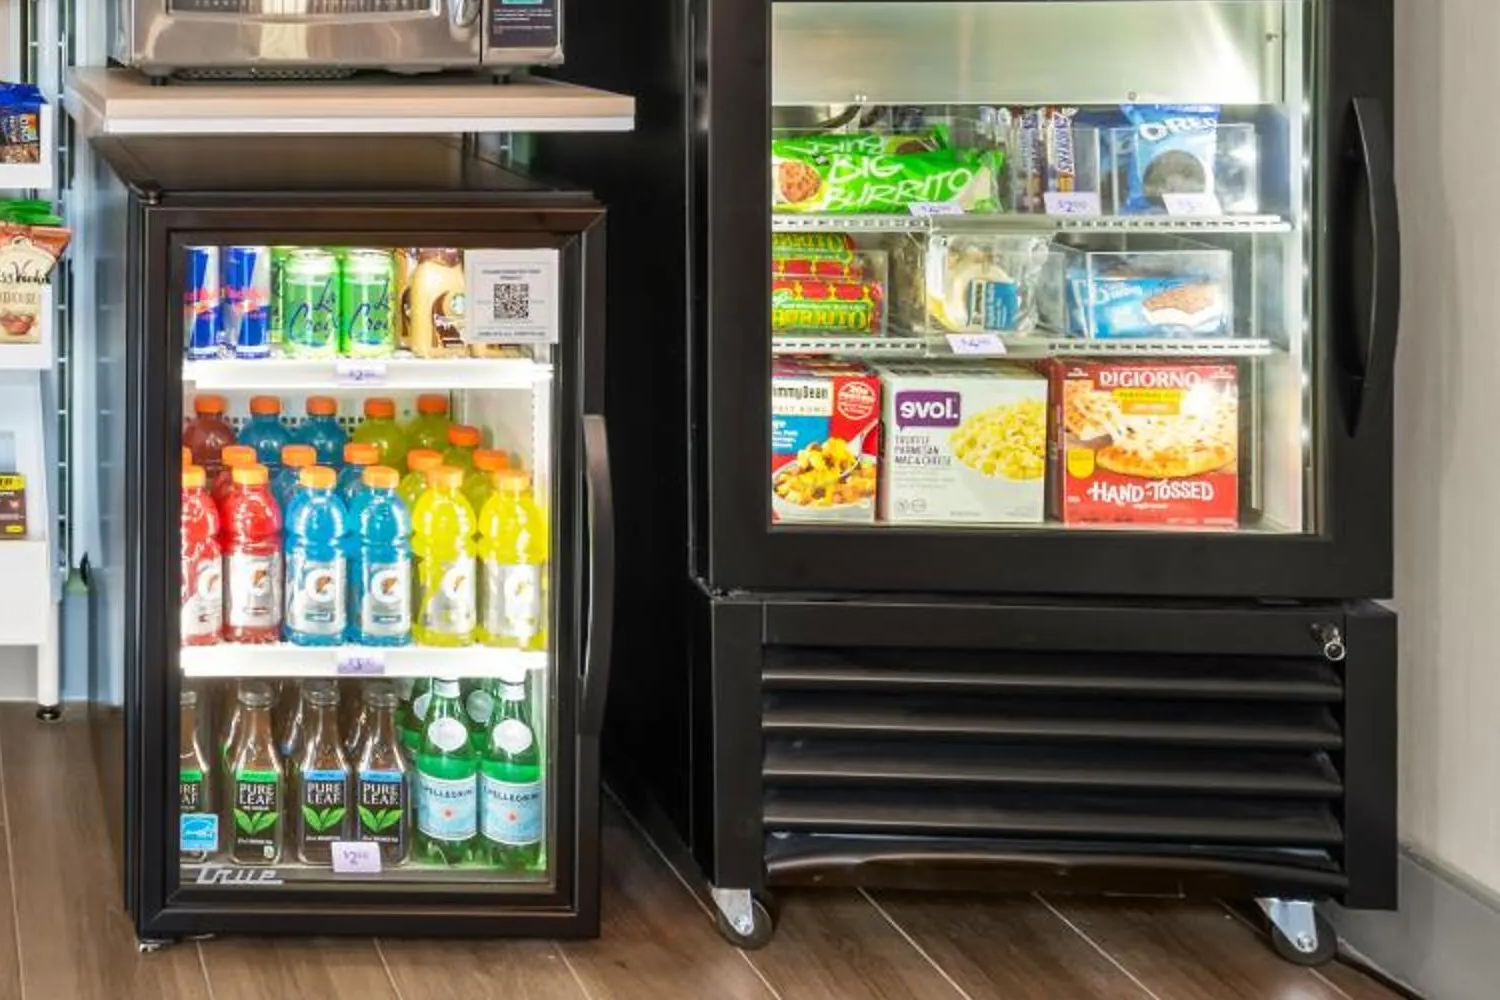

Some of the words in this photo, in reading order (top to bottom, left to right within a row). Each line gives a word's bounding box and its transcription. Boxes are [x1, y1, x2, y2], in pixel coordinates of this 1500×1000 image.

[1139, 116, 1218, 141] OREO
[823, 167, 973, 211] BURRITO
[1099, 370, 1201, 389] DIGIORNO
[239, 783, 274, 794] PURE
[307, 783, 341, 794] PURE
[363, 783, 398, 794] PURE
[239, 794, 274, 805] LEAF
[307, 794, 340, 804] LEAF
[363, 794, 398, 805] LEAF
